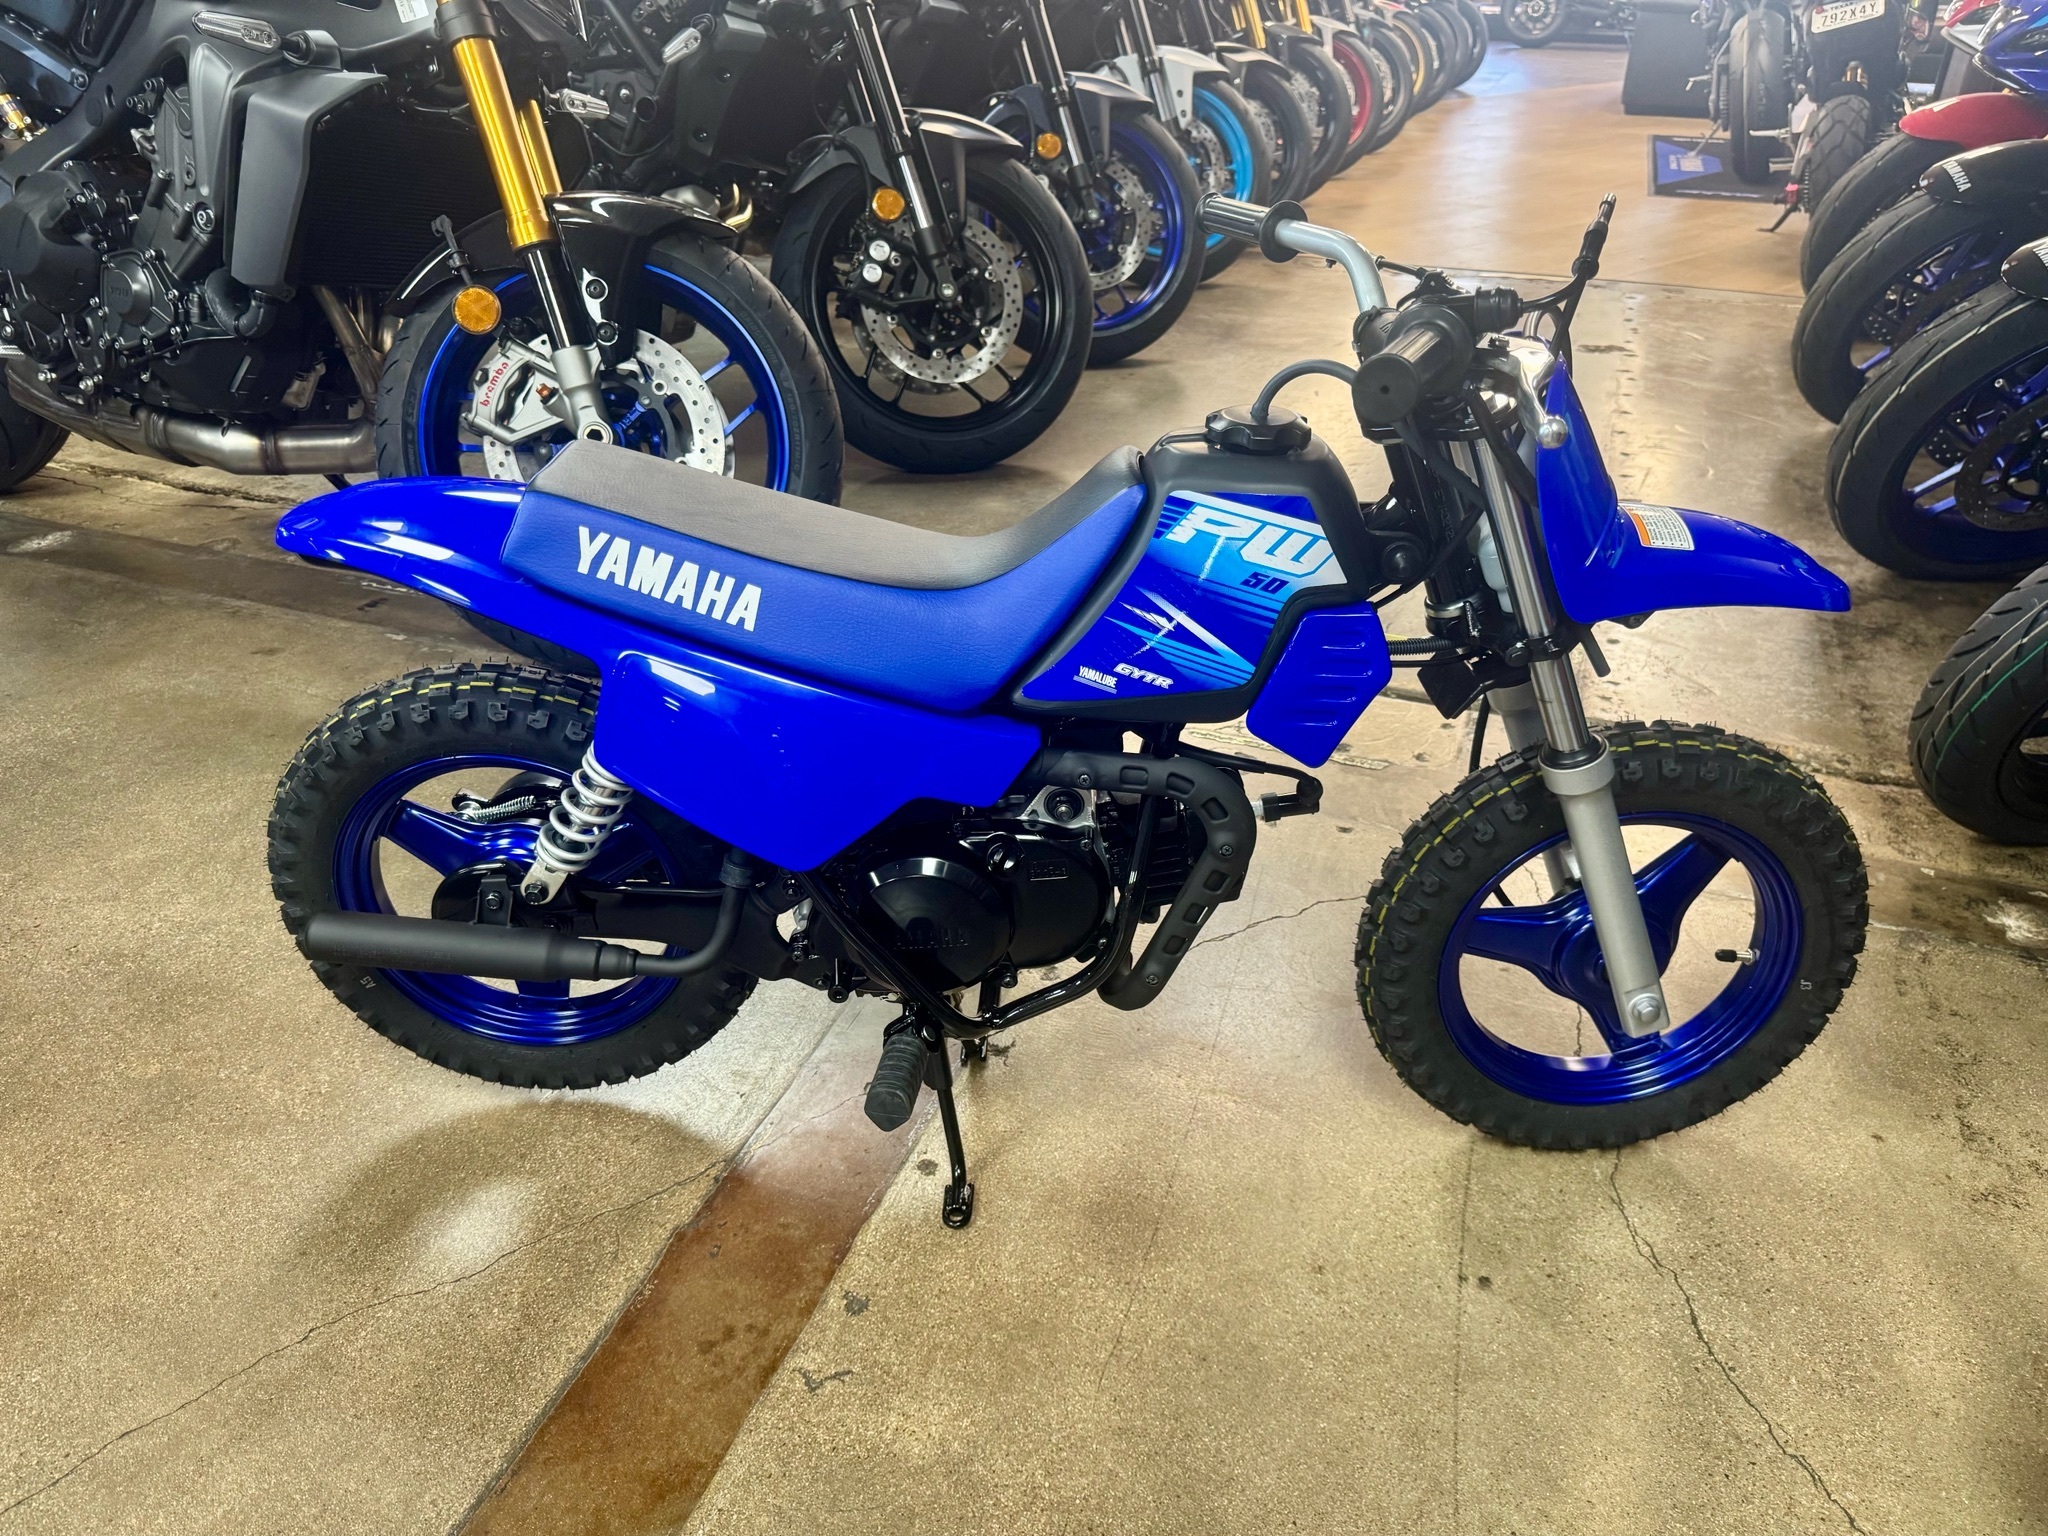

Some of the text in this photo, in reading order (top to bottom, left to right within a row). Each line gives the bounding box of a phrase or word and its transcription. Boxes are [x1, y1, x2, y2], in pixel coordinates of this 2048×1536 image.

[1822, 2, 1876, 26] 792X4Y
[480, 361, 509, 407] brembo
[1165, 505, 1334, 575] PW
[577, 525, 762, 632] YAMAHA
[1240, 571, 1289, 594] 50
[1079, 665, 1118, 688] YAMALUBE
[1113, 662, 1174, 689] GYTR
